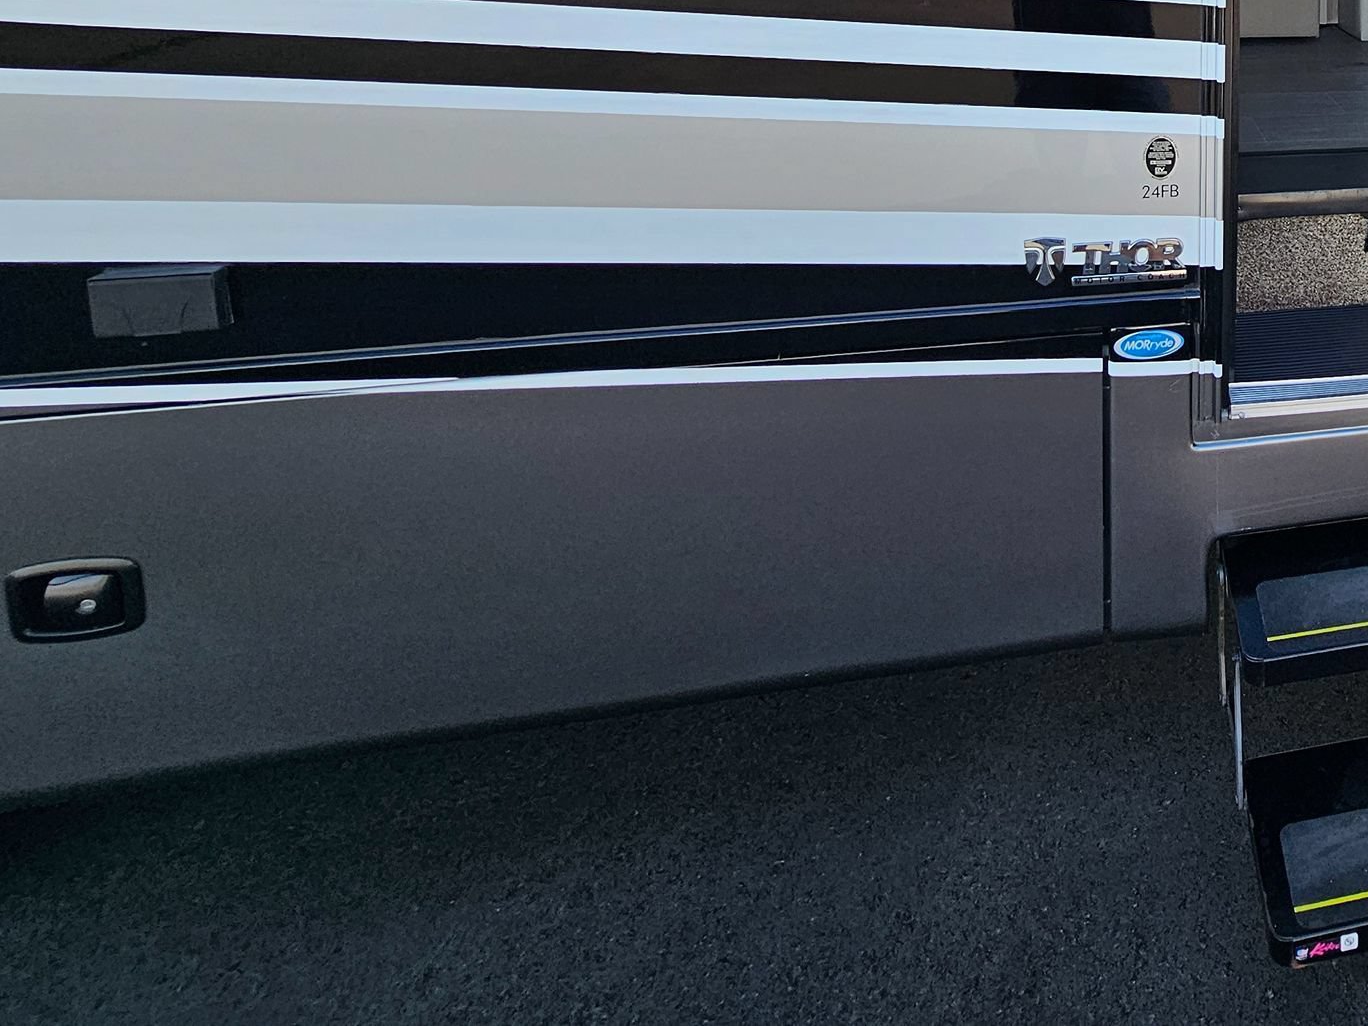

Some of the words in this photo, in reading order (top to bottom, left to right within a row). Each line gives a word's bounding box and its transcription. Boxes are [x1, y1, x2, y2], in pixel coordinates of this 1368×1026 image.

[1142, 184, 1179, 199] 24FB
[1072, 237, 1186, 274] THOR
[1074, 275, 1125, 285] MOTOR
[1137, 272, 1185, 281] COACH
[1123, 338, 1174, 351] MORryde
